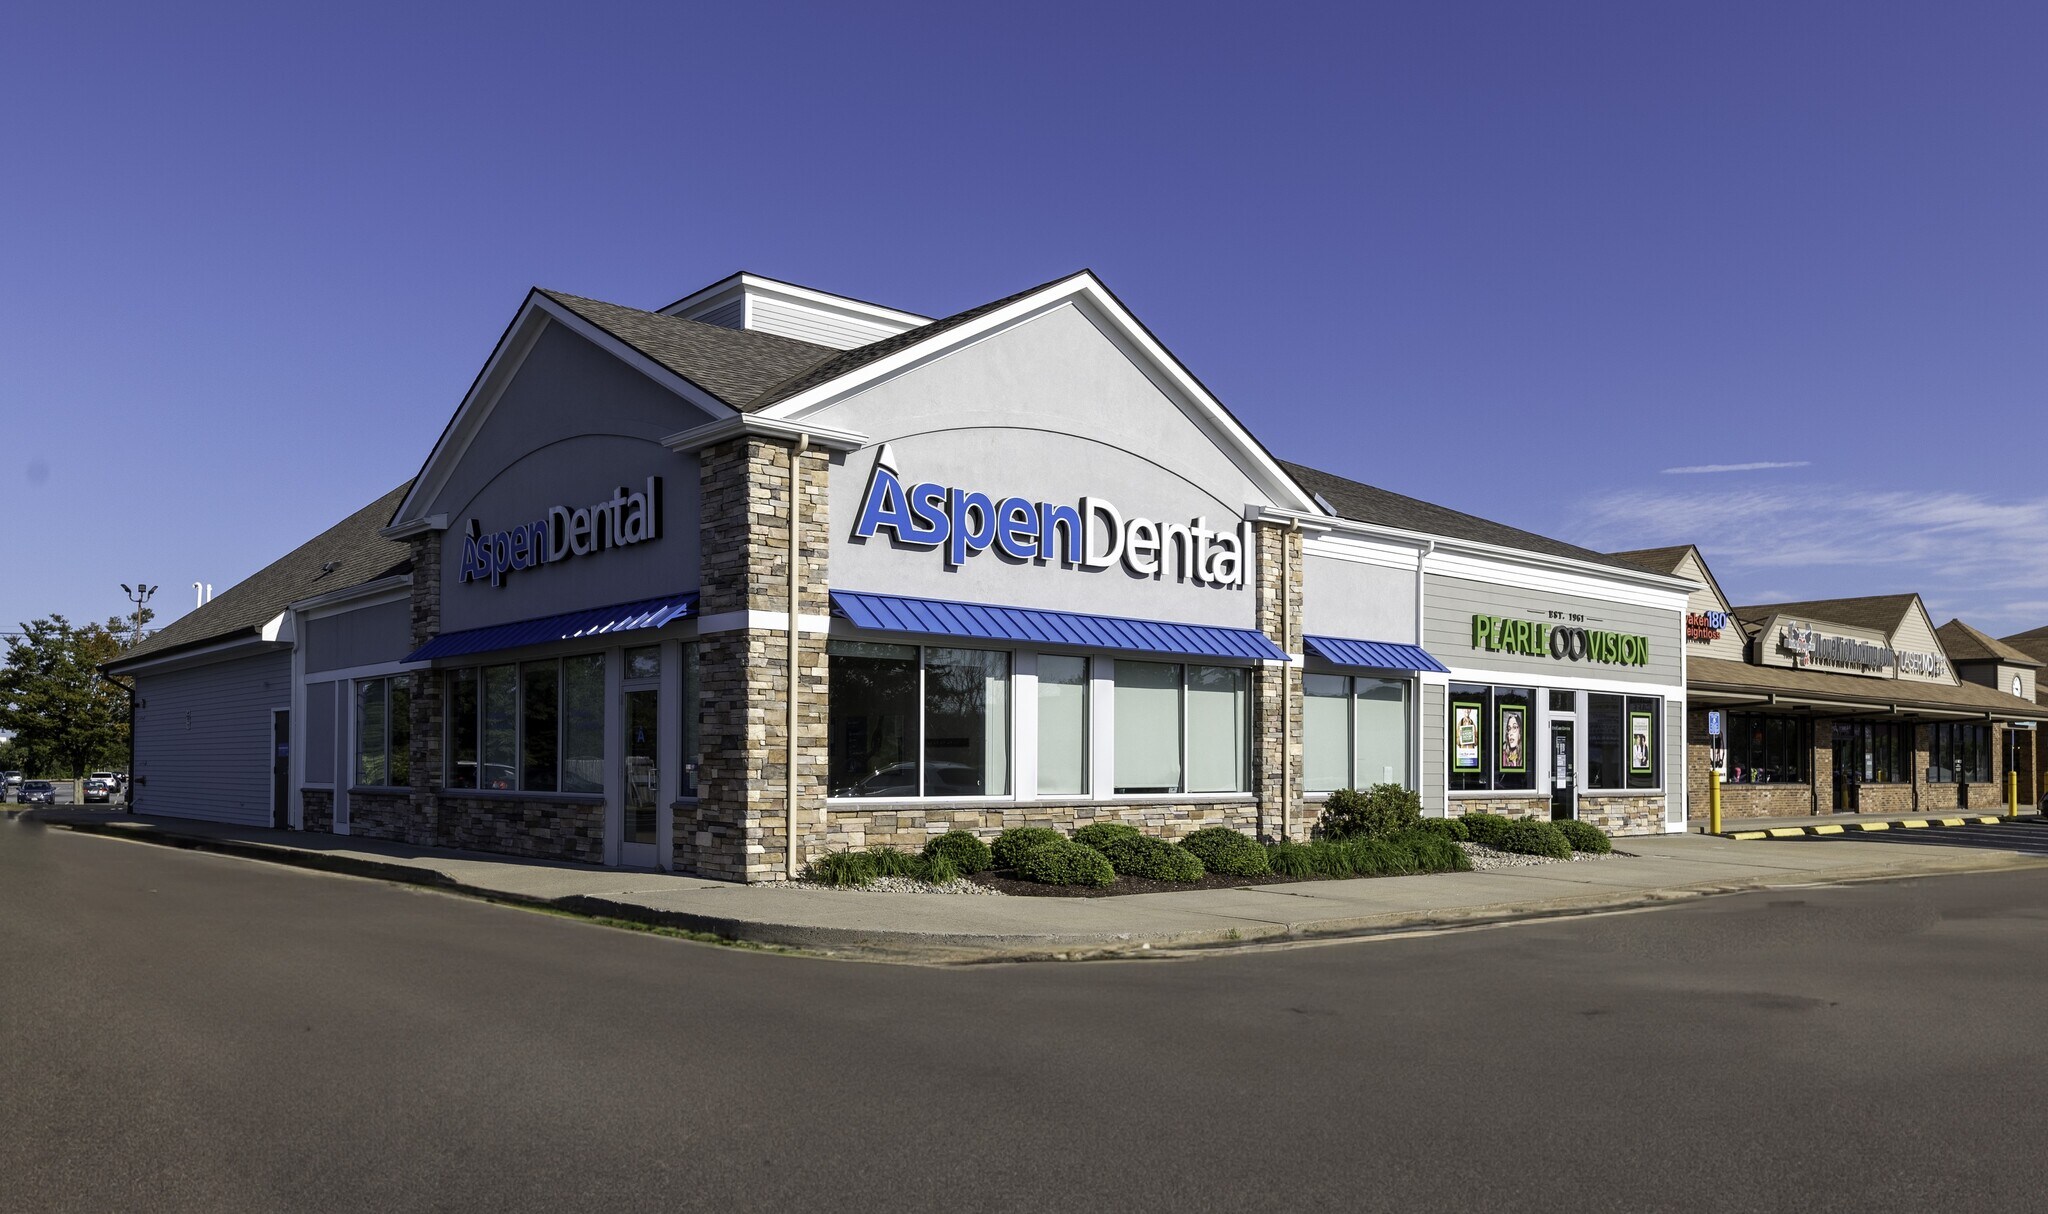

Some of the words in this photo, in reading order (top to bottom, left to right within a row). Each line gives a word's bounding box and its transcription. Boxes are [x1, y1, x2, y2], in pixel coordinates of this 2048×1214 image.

[1548, 610, 1565, 620] EST.
[1568, 613, 1585, 623] 1961
[1474, 614, 1551, 655] PEARLE
[1587, 629, 1648, 665] VISION
[1686, 626, 1721, 640] eightloss
